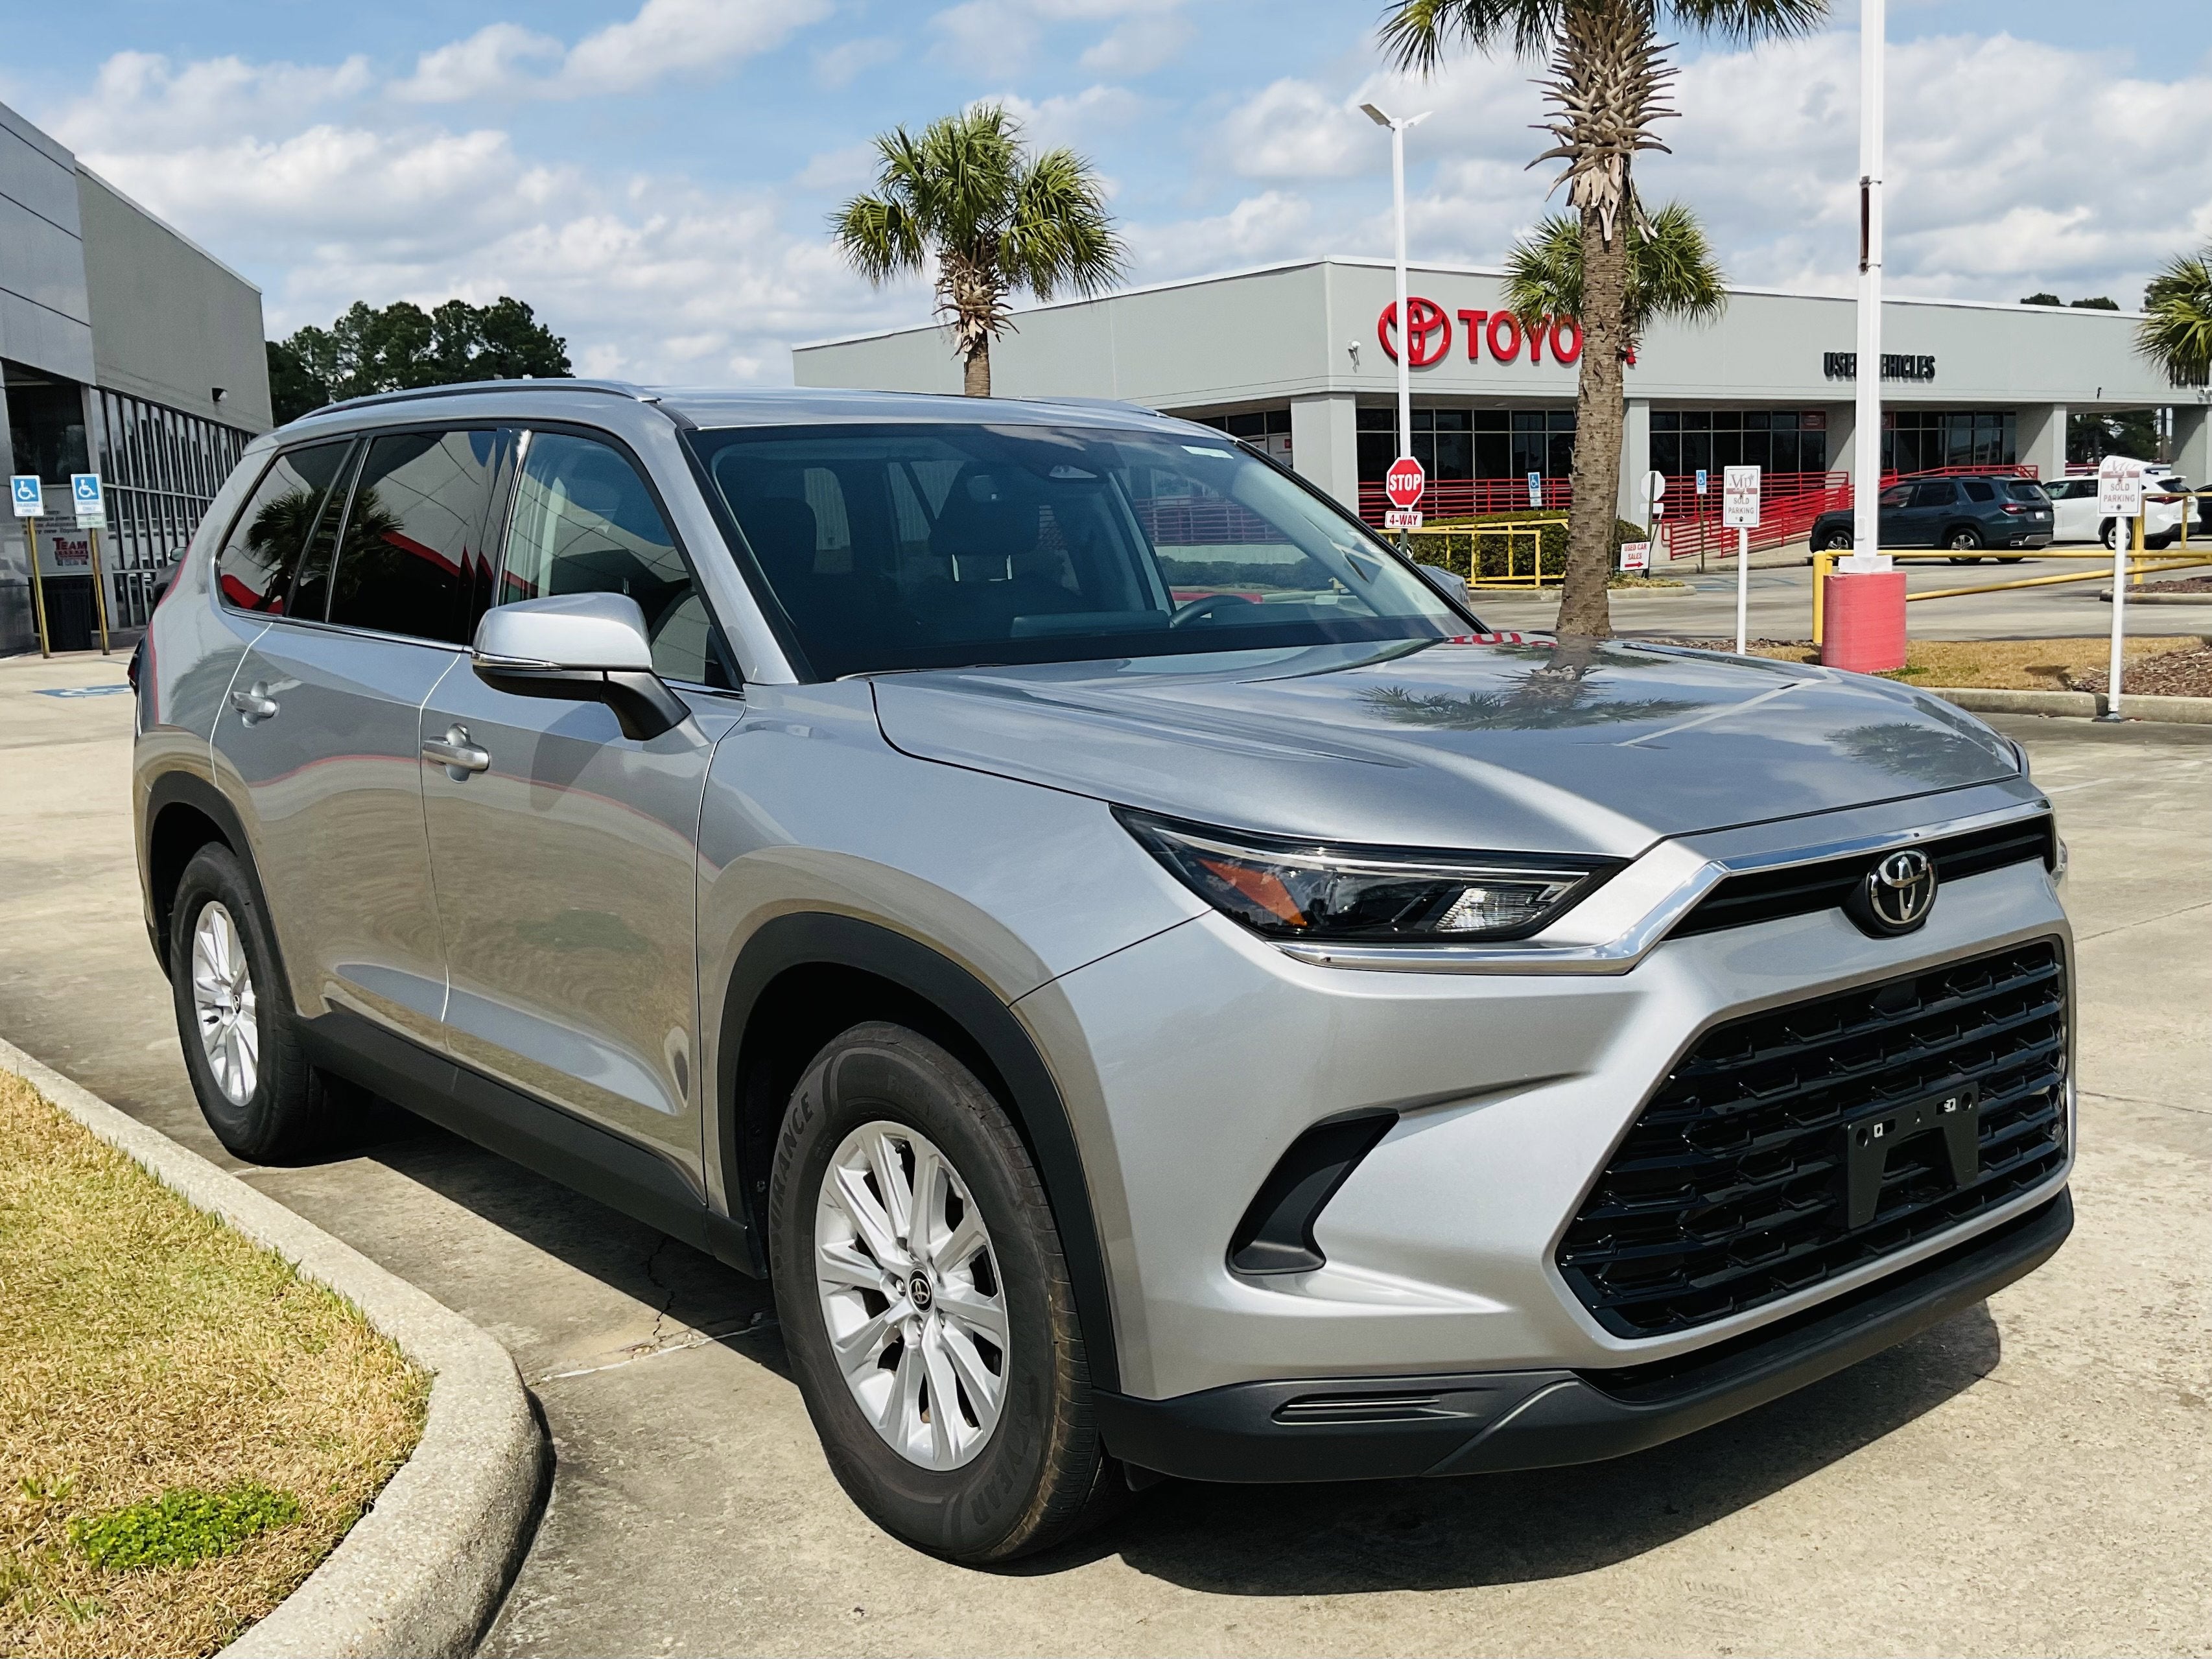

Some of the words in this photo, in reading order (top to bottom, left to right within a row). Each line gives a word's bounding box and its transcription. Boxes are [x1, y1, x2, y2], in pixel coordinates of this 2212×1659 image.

[1457, 309, 1636, 364] TOYO
[1824, 352, 1857, 377] USE
[1879, 353, 1935, 378] EHICLES
[1389, 474, 1421, 491] STOP
[1389, 514, 1418, 525] 4-WAY
